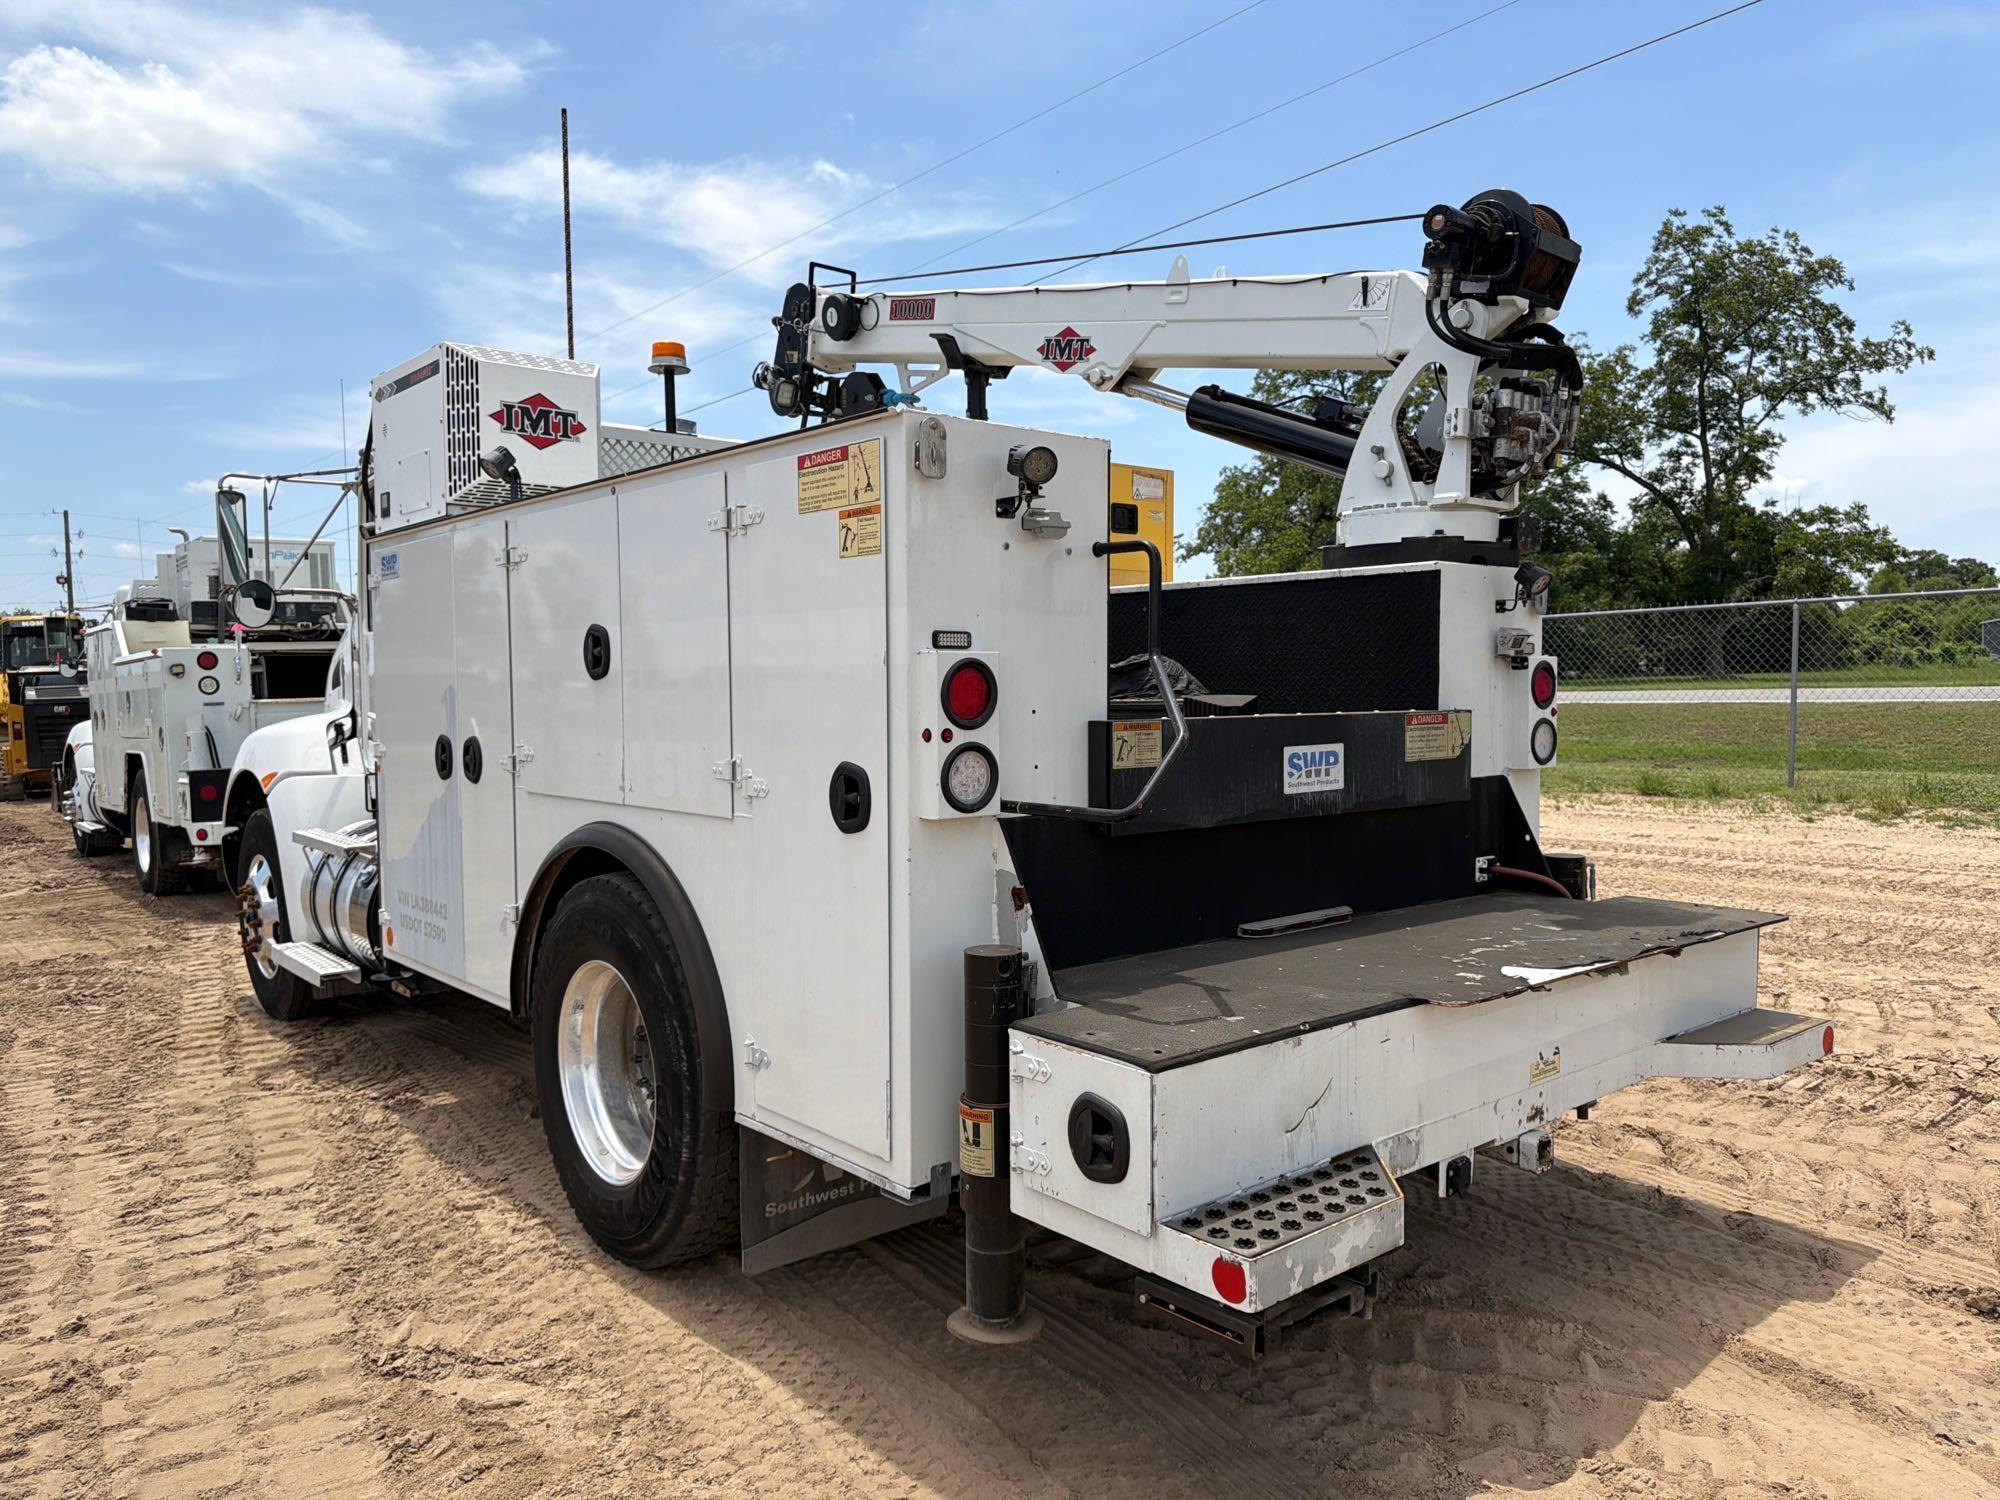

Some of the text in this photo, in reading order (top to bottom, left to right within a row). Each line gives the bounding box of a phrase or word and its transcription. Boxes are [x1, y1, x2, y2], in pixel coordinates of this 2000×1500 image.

[892, 300, 933, 320] 10000
[1042, 336, 1091, 362] IMT
[501, 401, 578, 441] IMT
[811, 450, 842, 465] DANGER
[1417, 715, 1443, 724] DANGER
[1287, 750, 1340, 779] SWP
[1287, 778, 1340, 789] Southwest Products
[764, 1181, 855, 1218] Southwest
